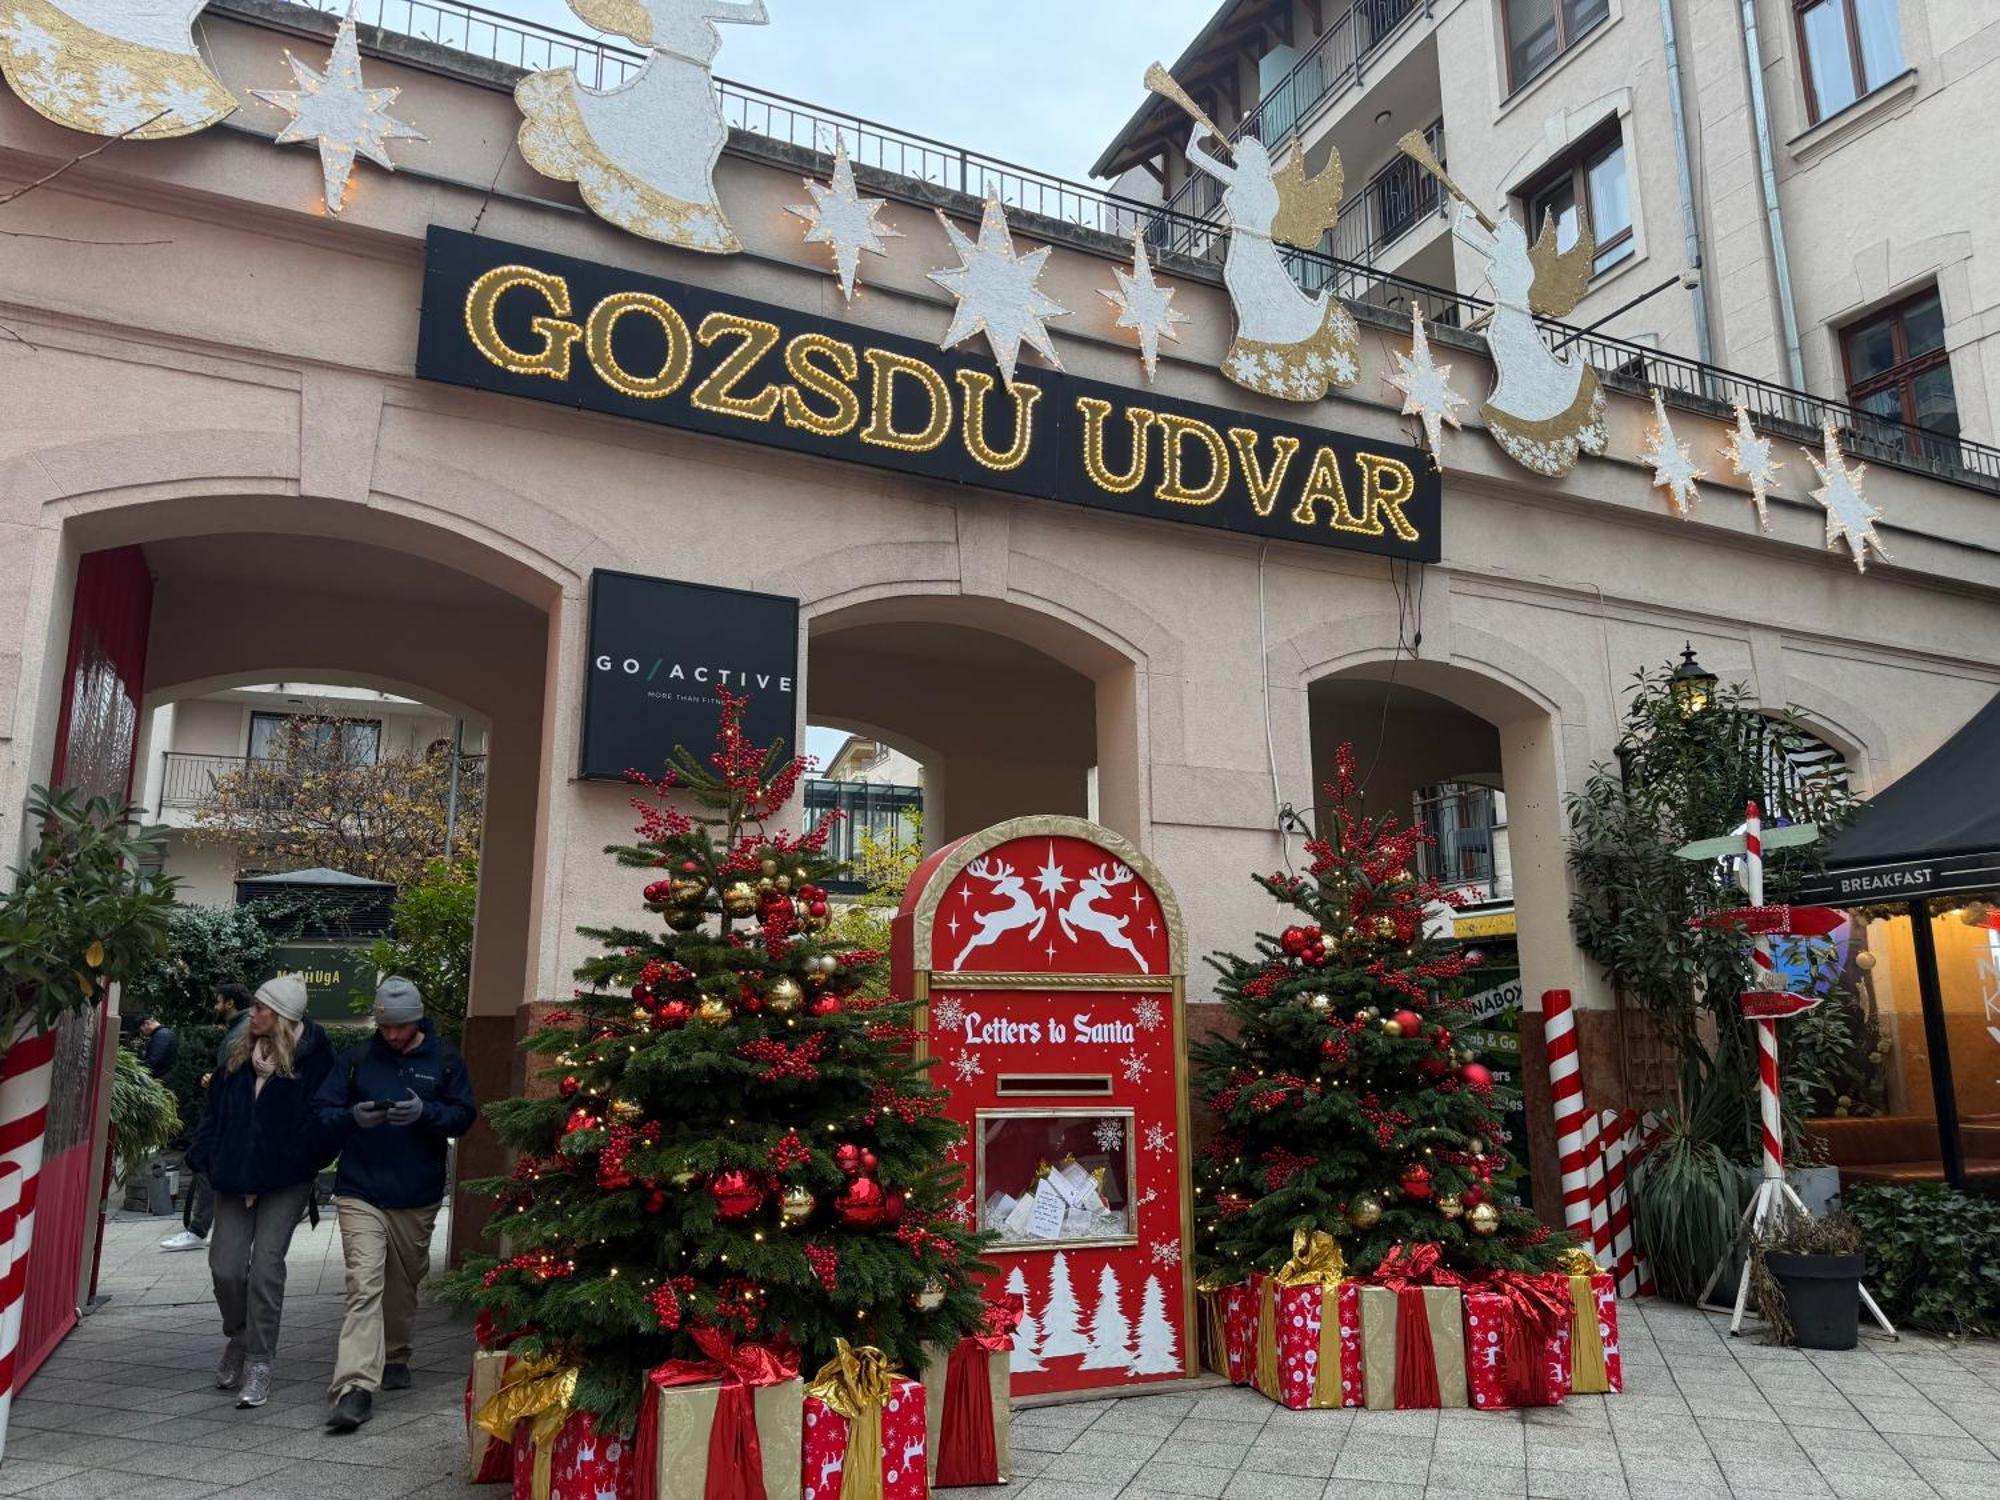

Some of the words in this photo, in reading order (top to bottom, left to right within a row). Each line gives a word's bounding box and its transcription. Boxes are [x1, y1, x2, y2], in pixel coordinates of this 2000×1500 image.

[464, 264, 1042, 472] GOZSDU
[1076, 396, 1421, 543] UDVAR
[647, 691, 673, 700] MORE
[676, 694, 699, 703] THAN
[1840, 868, 1933, 893] BREAKFAST
[964, 1010, 1042, 1045] Letters
[1048, 1017, 1067, 1044] to
[1073, 1012, 1136, 1045] Santa
[1499, 1035, 1518, 1050] Go
